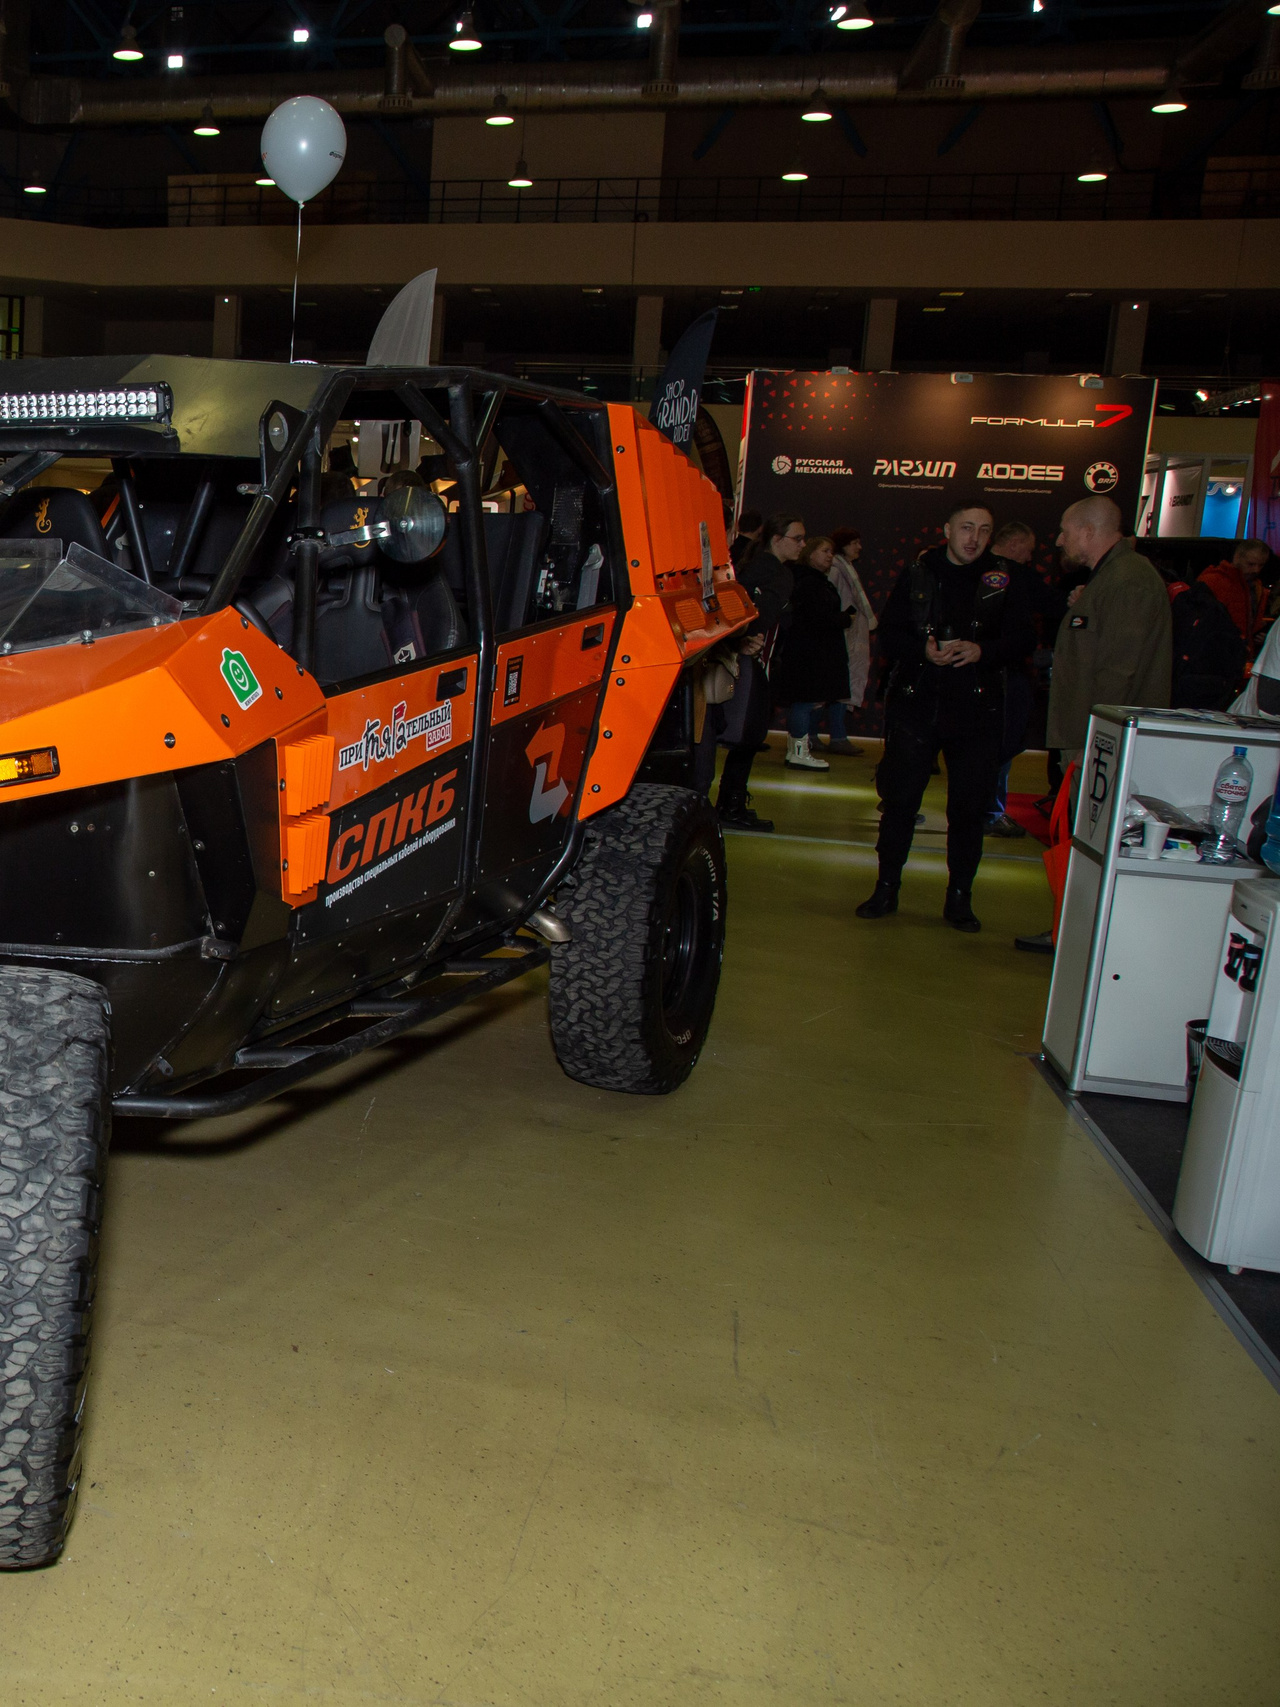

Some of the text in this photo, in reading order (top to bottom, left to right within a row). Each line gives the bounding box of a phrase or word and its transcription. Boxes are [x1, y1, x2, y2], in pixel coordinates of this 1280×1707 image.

[664, 379, 685, 402] SHOP
[794, 466, 854, 476] МЕХАНИКА
[795, 458, 844, 467] РУССКАЯ
[872, 459, 957, 478] PARSUN
[976, 463, 1065, 482] AODES
[428, 723, 451, 745] ЗАВОД
[326, 768, 458, 885] СПКБ
[325, 873, 365, 908] производство
[363, 852, 400, 883] специальных
[398, 836, 420, 862] кабелей
[422, 817, 457, 846] оборудования
